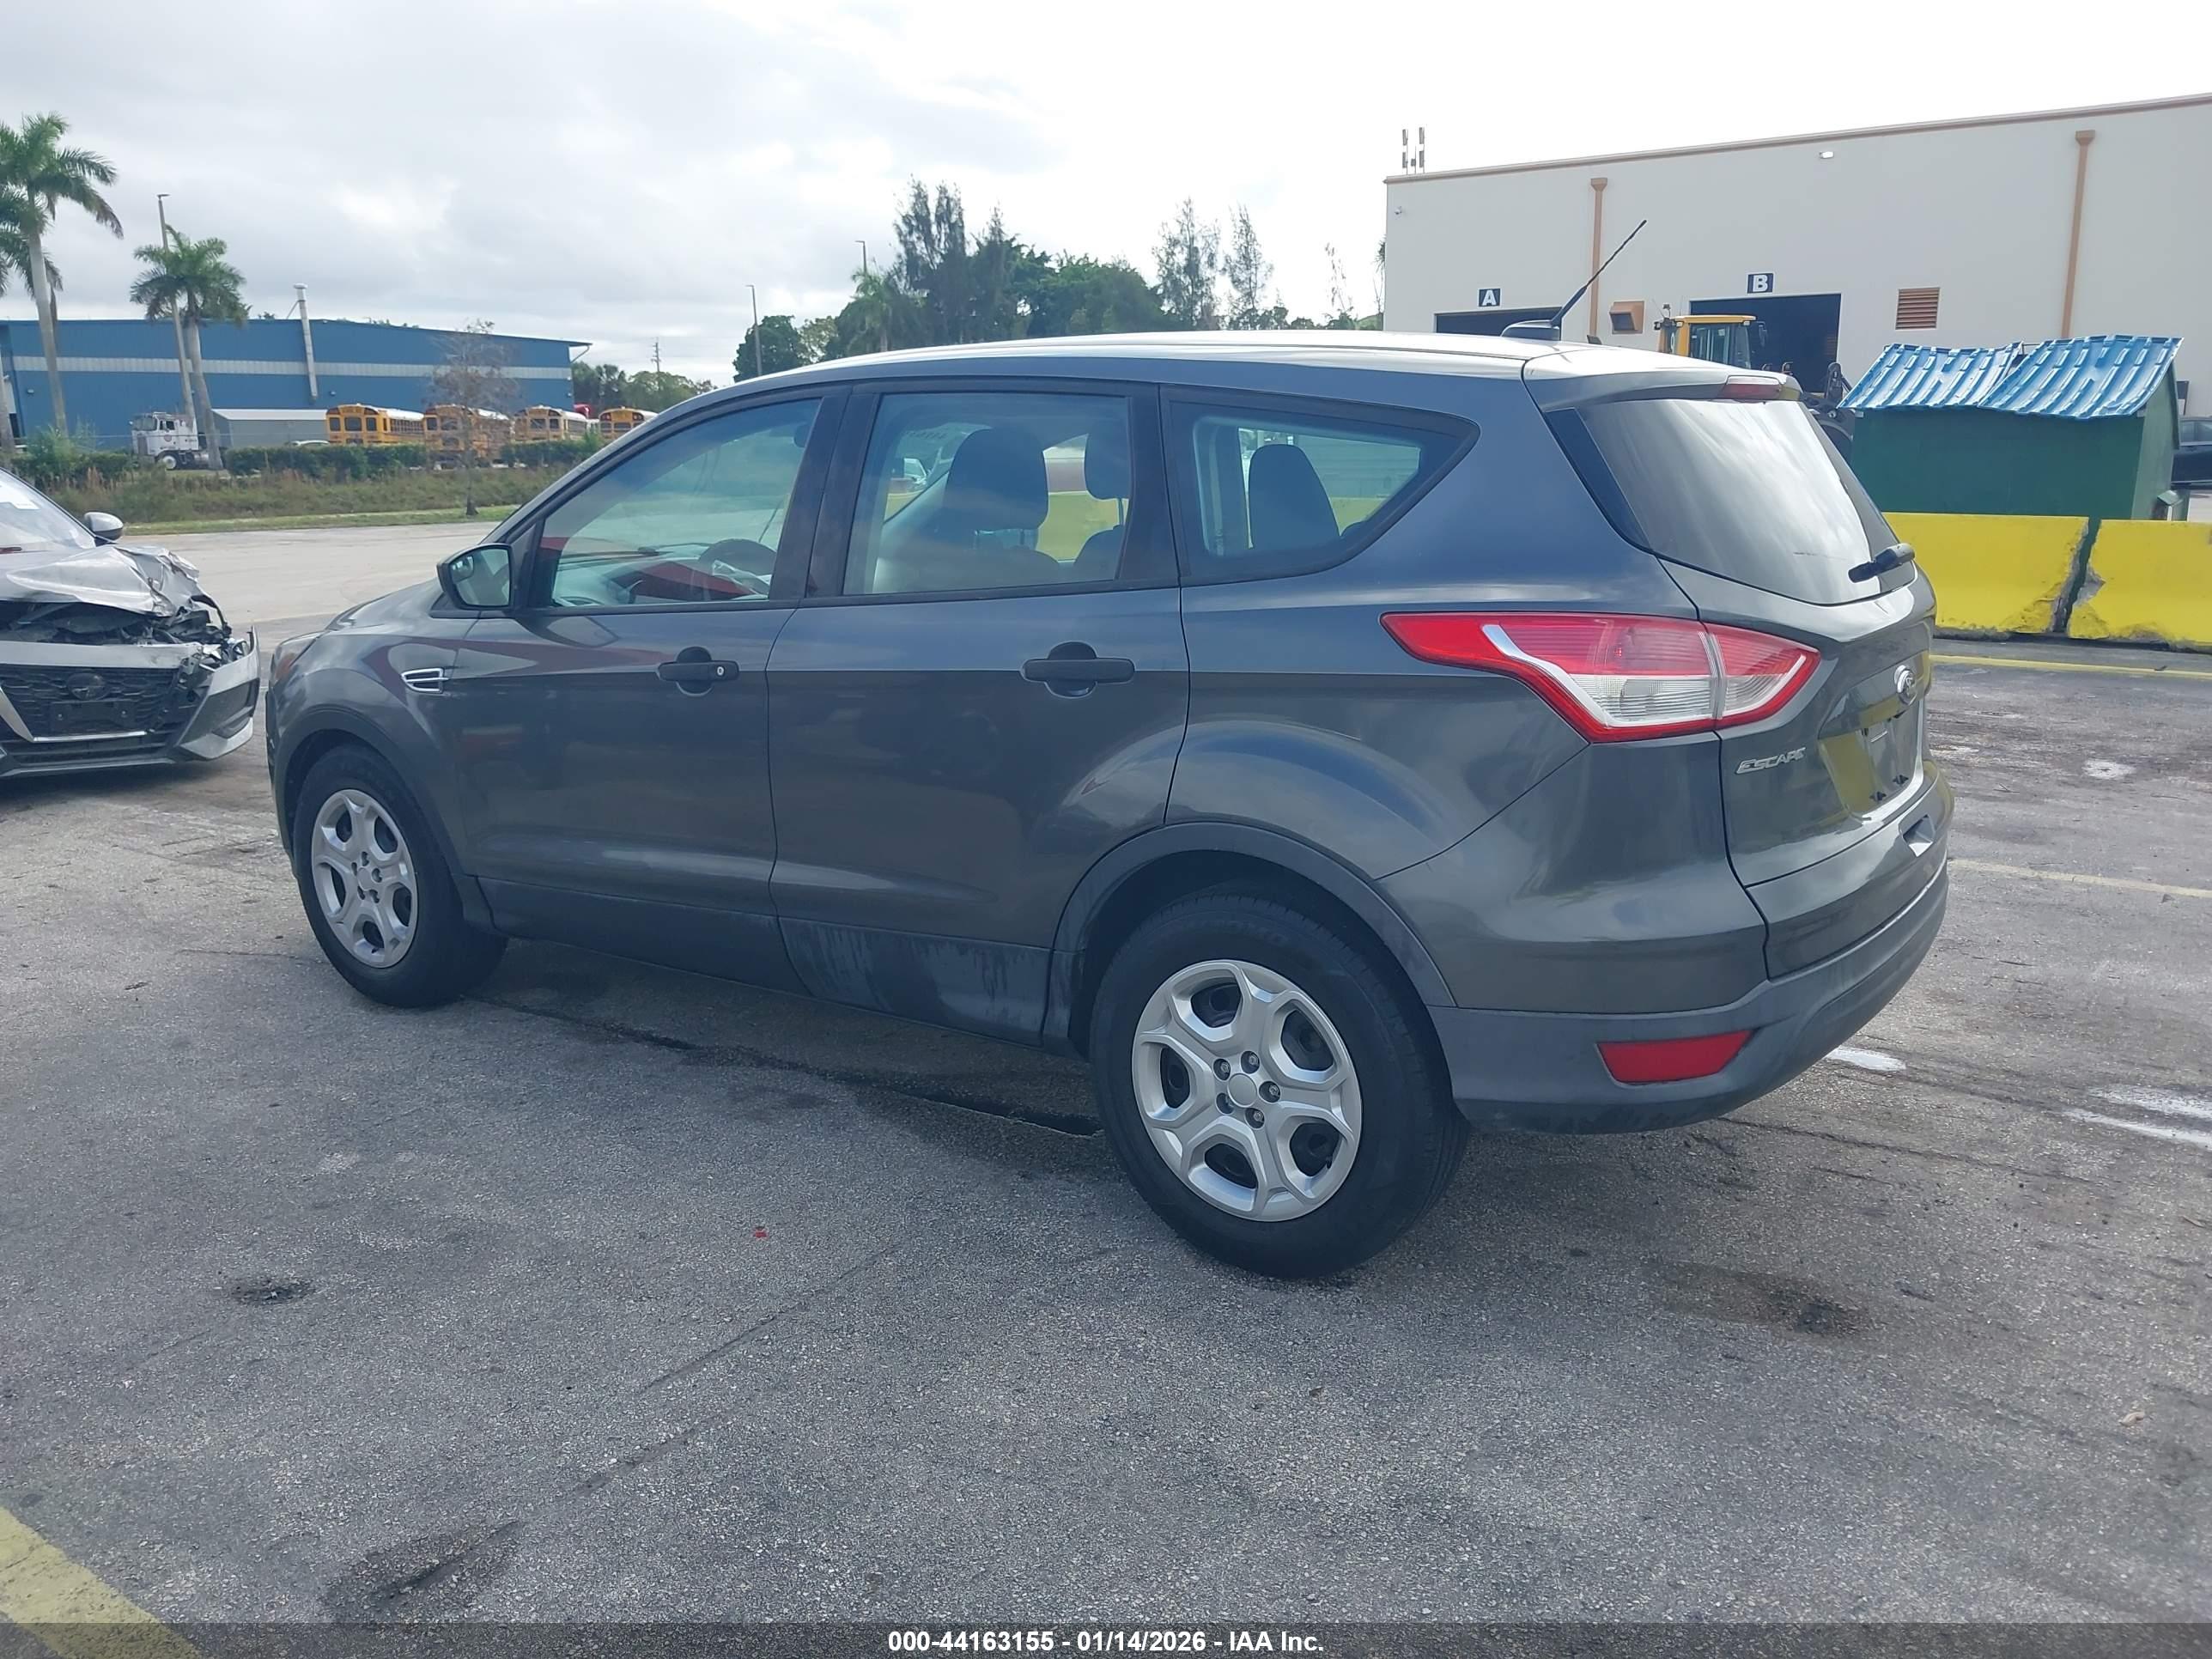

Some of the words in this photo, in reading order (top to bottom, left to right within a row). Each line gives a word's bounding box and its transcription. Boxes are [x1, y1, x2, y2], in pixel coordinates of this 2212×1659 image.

[1753, 275, 1769, 292] B
[1481, 289, 1497, 307] A
[1735, 746, 1807, 775] ESCAPE
